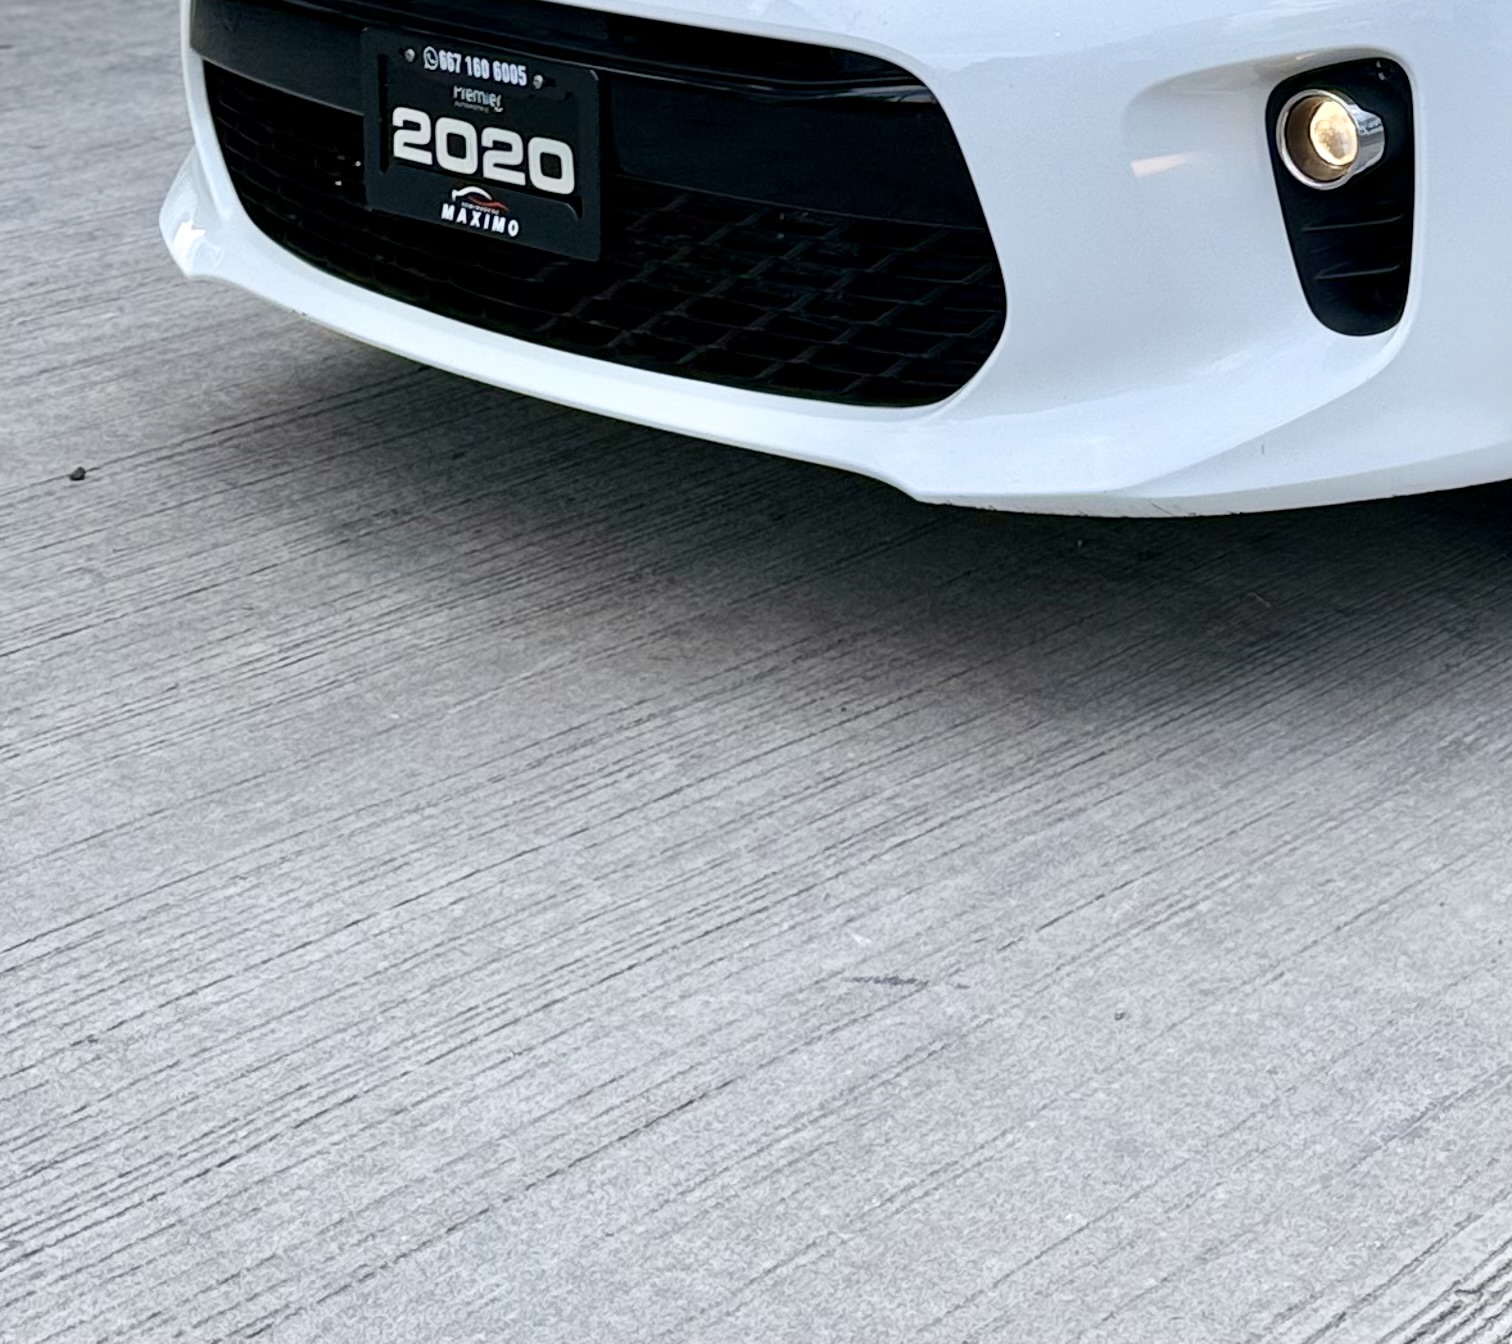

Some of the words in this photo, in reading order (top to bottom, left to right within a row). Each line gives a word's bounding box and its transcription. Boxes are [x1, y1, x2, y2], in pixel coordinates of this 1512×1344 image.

[438, 50, 461, 73] 667
[465, 56, 490, 79] 160
[493, 61, 527, 86] 6005
[392, 107, 575, 194] 2020
[441, 203, 519, 237] MAXIMO
